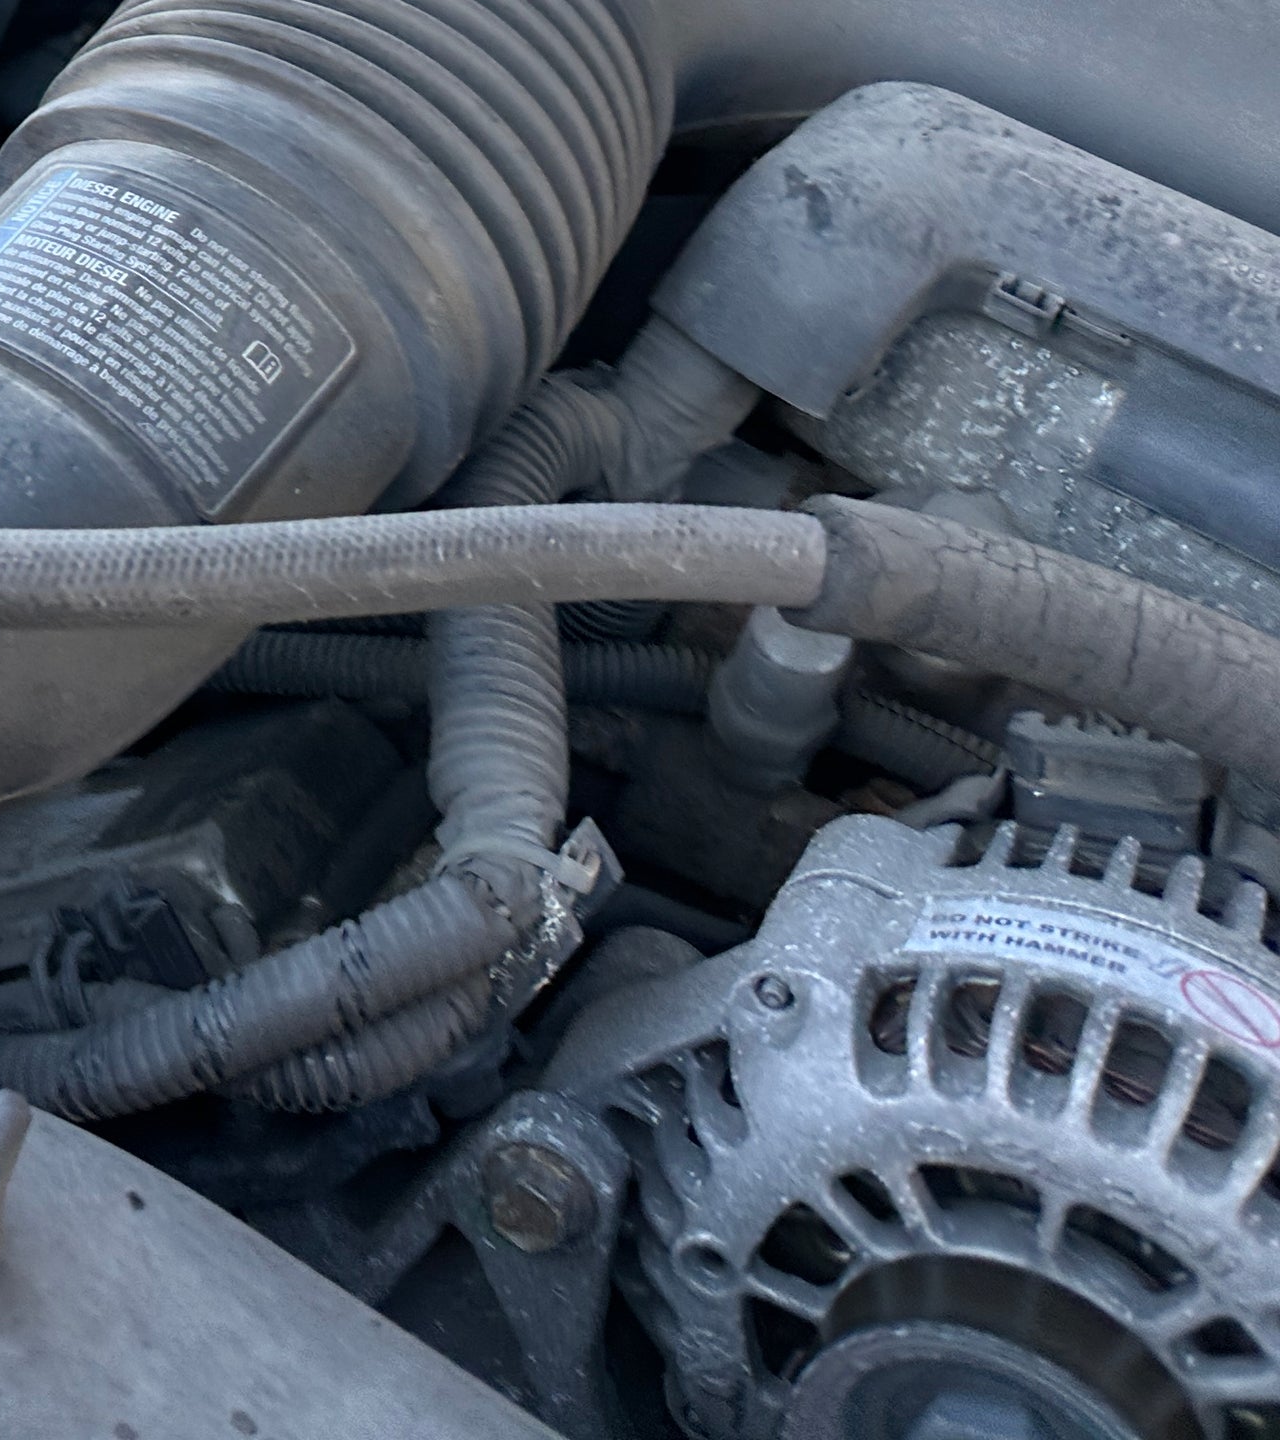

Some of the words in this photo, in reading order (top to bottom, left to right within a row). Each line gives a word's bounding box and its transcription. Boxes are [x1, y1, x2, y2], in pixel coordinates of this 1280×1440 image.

[10, 180, 63, 222] NOTICE
[53, 226, 83, 241] Plug
[77, 234, 128, 261] Starting
[123, 254, 169, 286] System
[166, 280, 190, 301] can
[66, 178, 123, 199] DIESEL
[116, 191, 181, 224] ENGINE
[189, 226, 210, 243] Do
[206, 237, 229, 257] not
[226, 252, 250, 273] use
[247, 266, 290, 310] starting
[111, 205, 154, 228] engine
[149, 222, 199, 254] damage
[196, 248, 221, 268] can
[10, 234, 79, 260] MOTEUR
[73, 252, 133, 288] DIESEL
[133, 286, 154, 303] Ne
[150, 298, 175, 320] pas
[78, 271, 104, 289] Des
[100, 282, 165, 331] dommages
[99, 214, 146, 239] nominal
[144, 234, 163, 247] 12
[158, 241, 190, 264] volts
[200, 266, 251, 312] electrical
[247, 306, 285, 346] system
[175, 267, 216, 302] Failure
[25, 294, 69, 320] charge
[44, 287, 74, 306] plus
[88, 308, 107, 323] 12
[103, 317, 135, 344] volts
[59, 325, 106, 362] pourrait
[108, 303, 130, 321] Ne
[126, 316, 150, 338] pas
[147, 330, 200, 379] appliquer
[98, 367, 144, 410] bougies
[930, 928, 996, 944] WITH
[1004, 935, 1128, 974] HAMMER
[974, 914, 1031, 930] NOT
[1039, 922, 1141, 959] STRIKE
